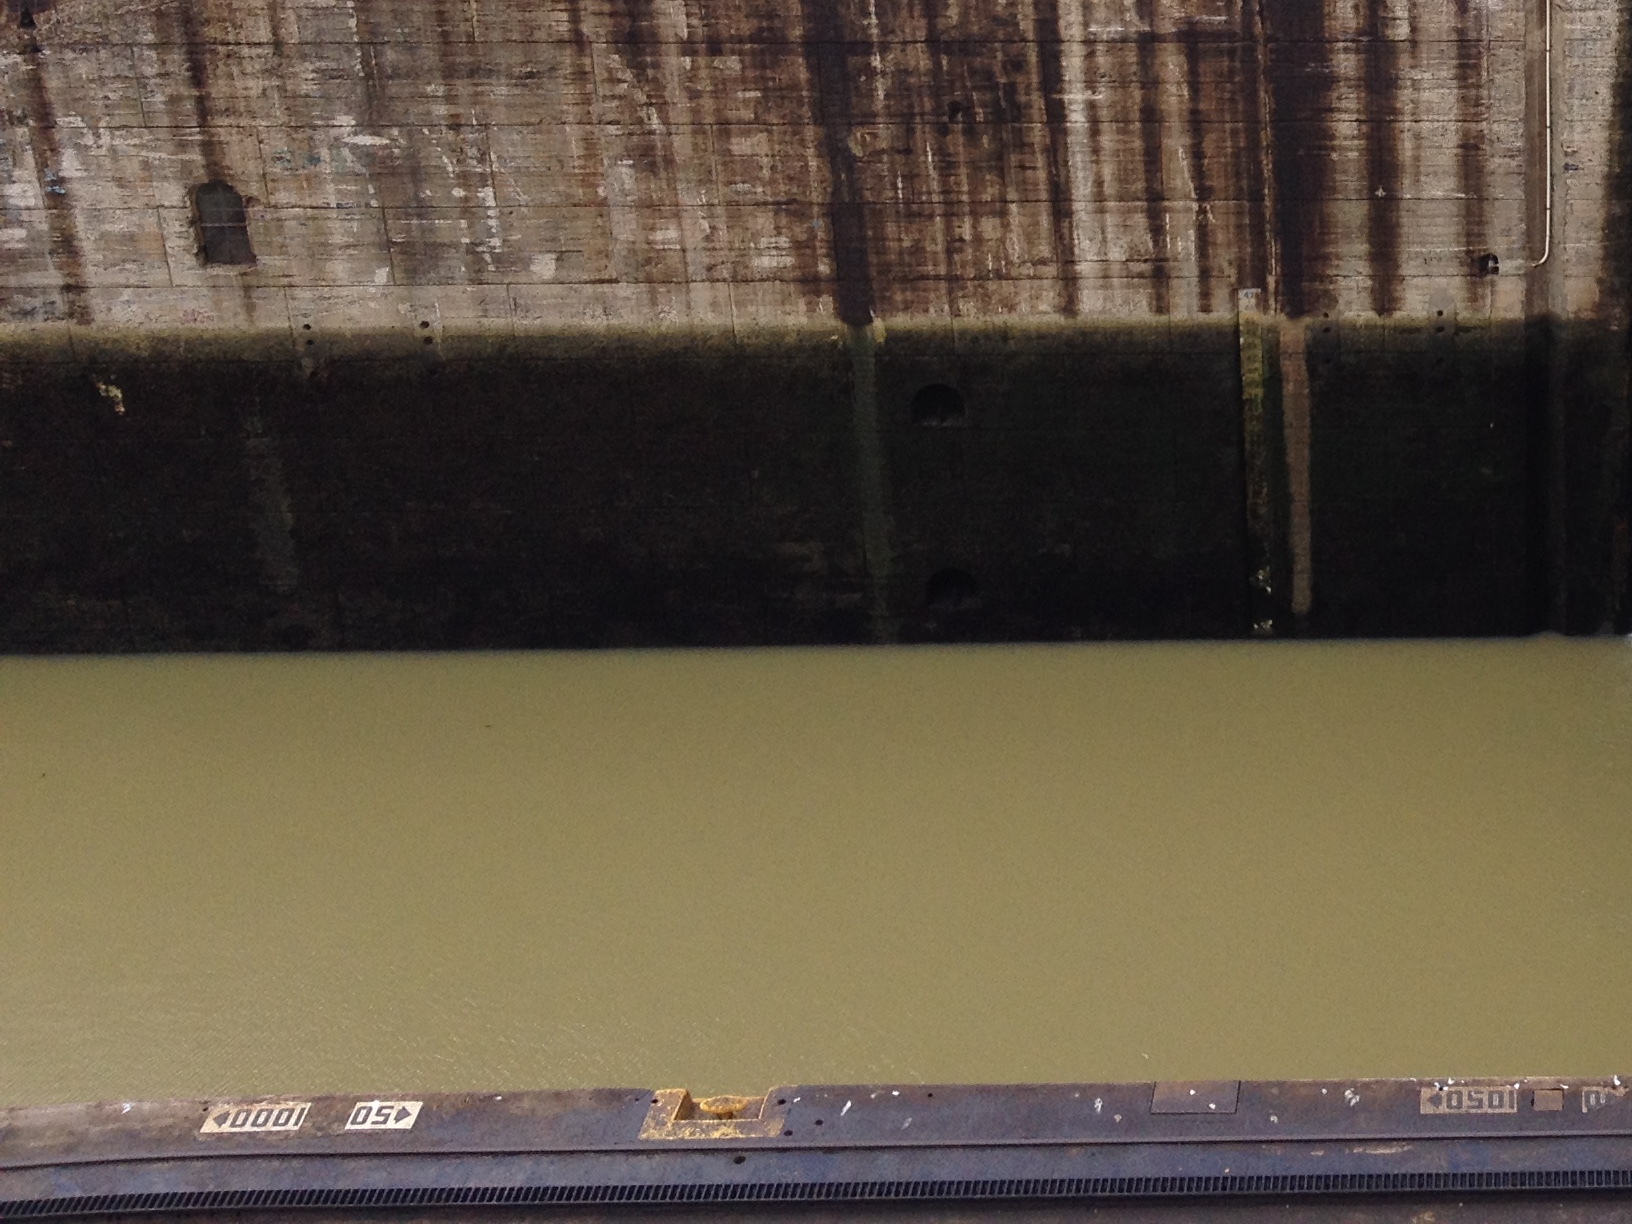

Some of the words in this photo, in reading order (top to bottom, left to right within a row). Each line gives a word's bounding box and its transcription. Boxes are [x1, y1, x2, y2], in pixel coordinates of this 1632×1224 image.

[1445, 1089, 1516, 1110] 1050
[229, 1106, 307, 1128] 1000
[350, 1105, 395, 1126] 50
